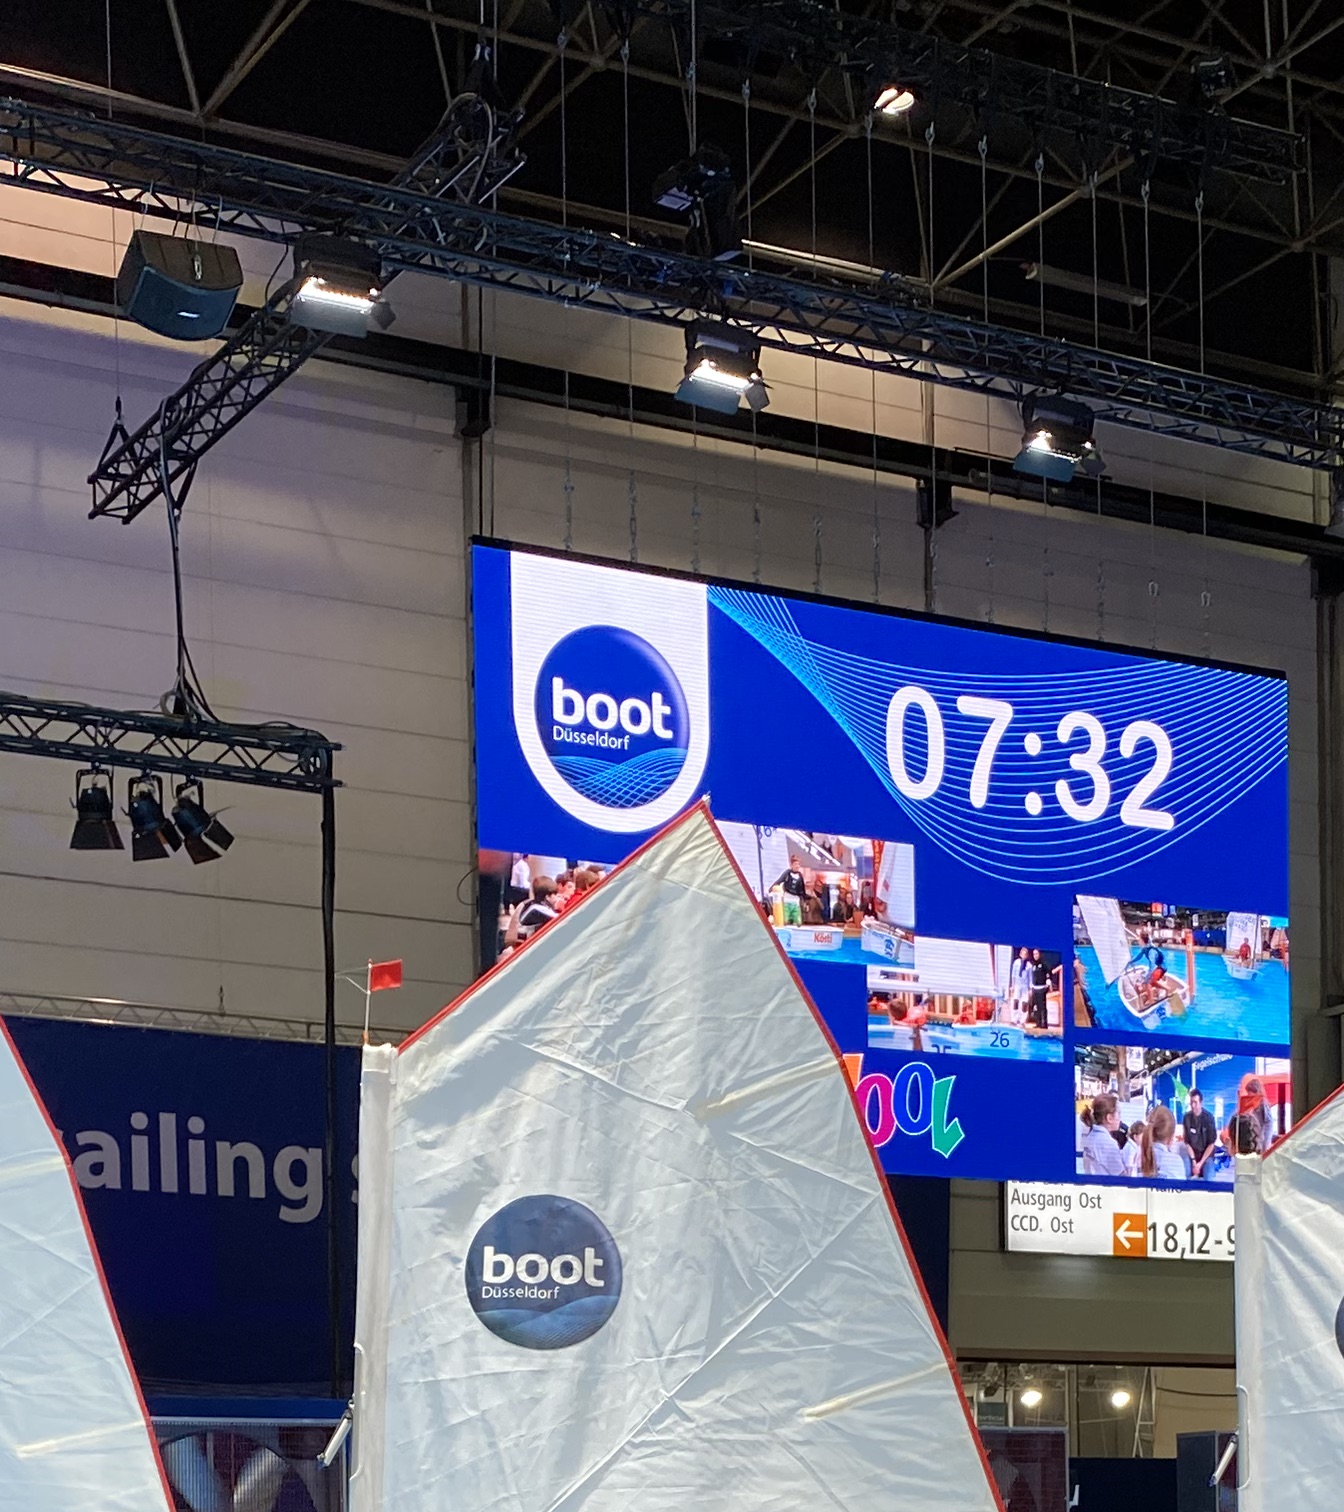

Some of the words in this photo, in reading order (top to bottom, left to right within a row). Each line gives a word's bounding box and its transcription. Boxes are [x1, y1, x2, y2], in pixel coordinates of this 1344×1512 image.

[552, 676, 673, 739] boot
[553, 725, 630, 750] Düsseldorf
[886, 686, 1175, 831] 07:32
[989, 1030, 1010, 1048] 26
[57, 1111, 324, 1223] ailing
[1010, 1188, 1072, 1212] Ausgang
[1079, 1192, 1102, 1209] Ost
[1010, 1214, 1043, 1233] CCD.
[1050, 1217, 1074, 1234] Ost
[482, 1245, 605, 1288] boot
[481, 1286, 560, 1299] Düsseldorf
